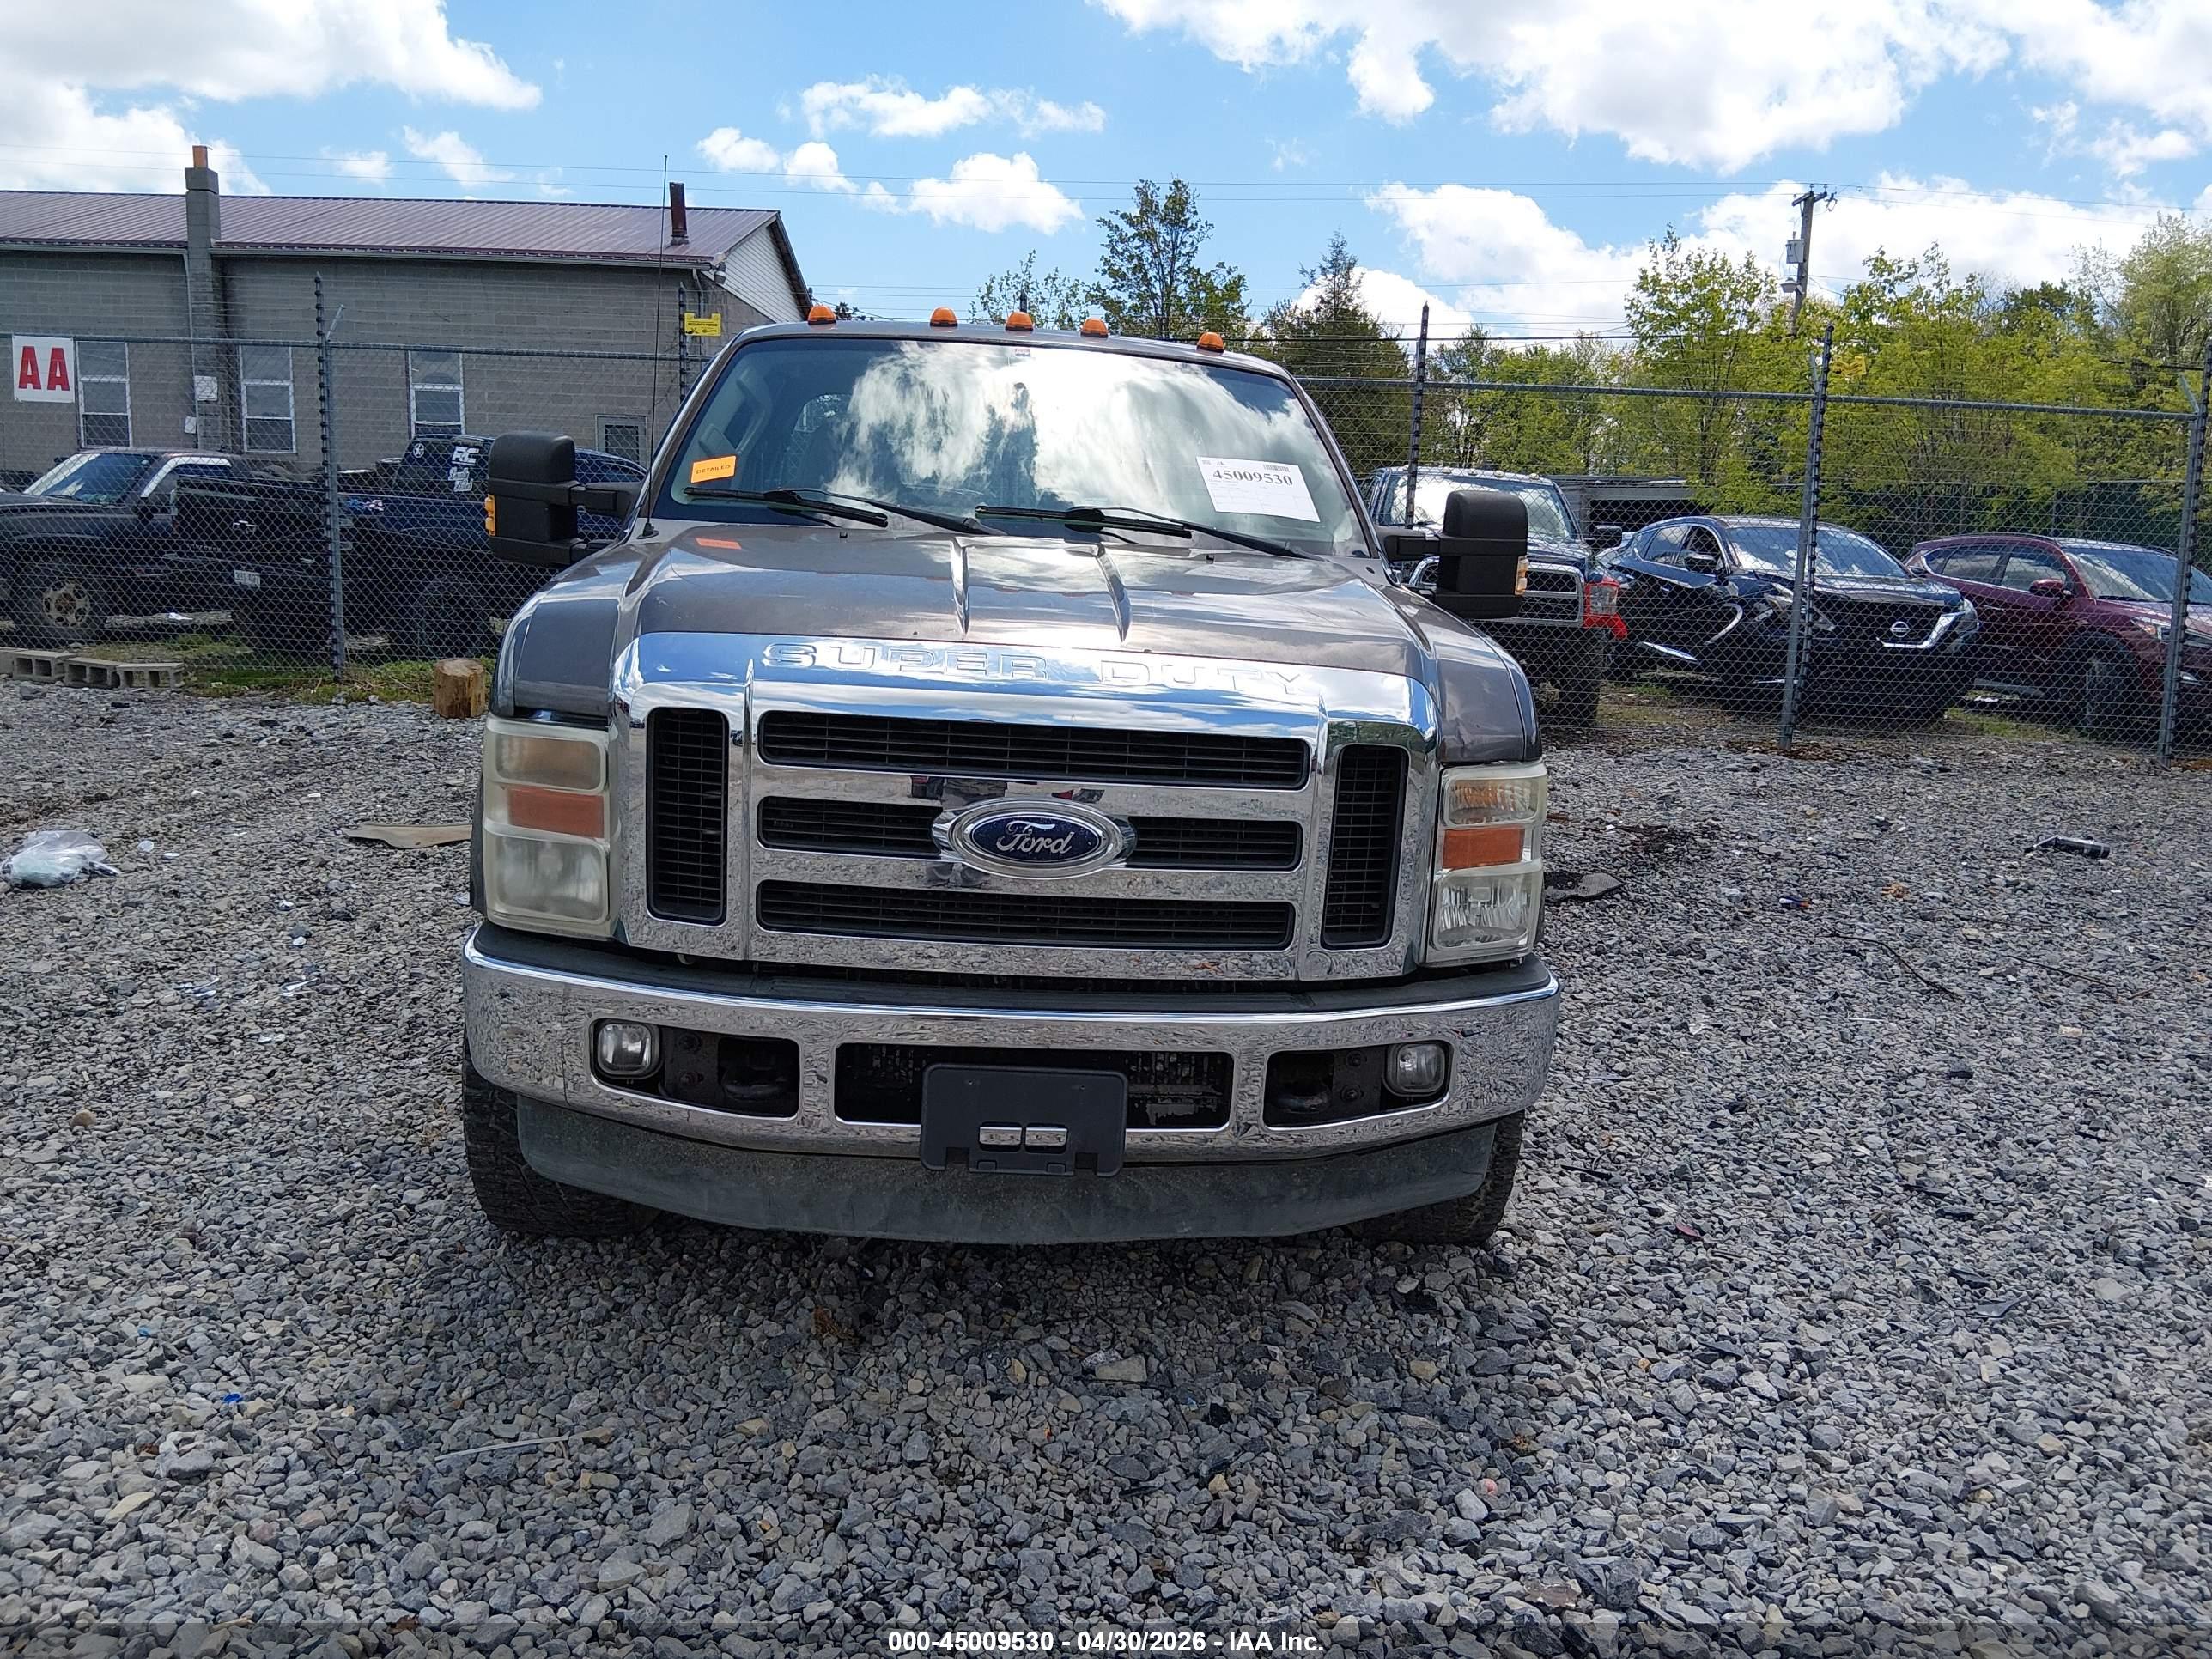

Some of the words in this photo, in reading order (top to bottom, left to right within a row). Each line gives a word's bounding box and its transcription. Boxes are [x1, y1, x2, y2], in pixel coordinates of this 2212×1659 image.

[18, 345, 70, 392] AA
[696, 464, 731, 475] DETAILED
[1212, 469, 1293, 486] 45009530
[762, 642, 1048, 682] SUPER
[1099, 659, 1315, 696] DUTY
[995, 820, 1074, 854] Ford
